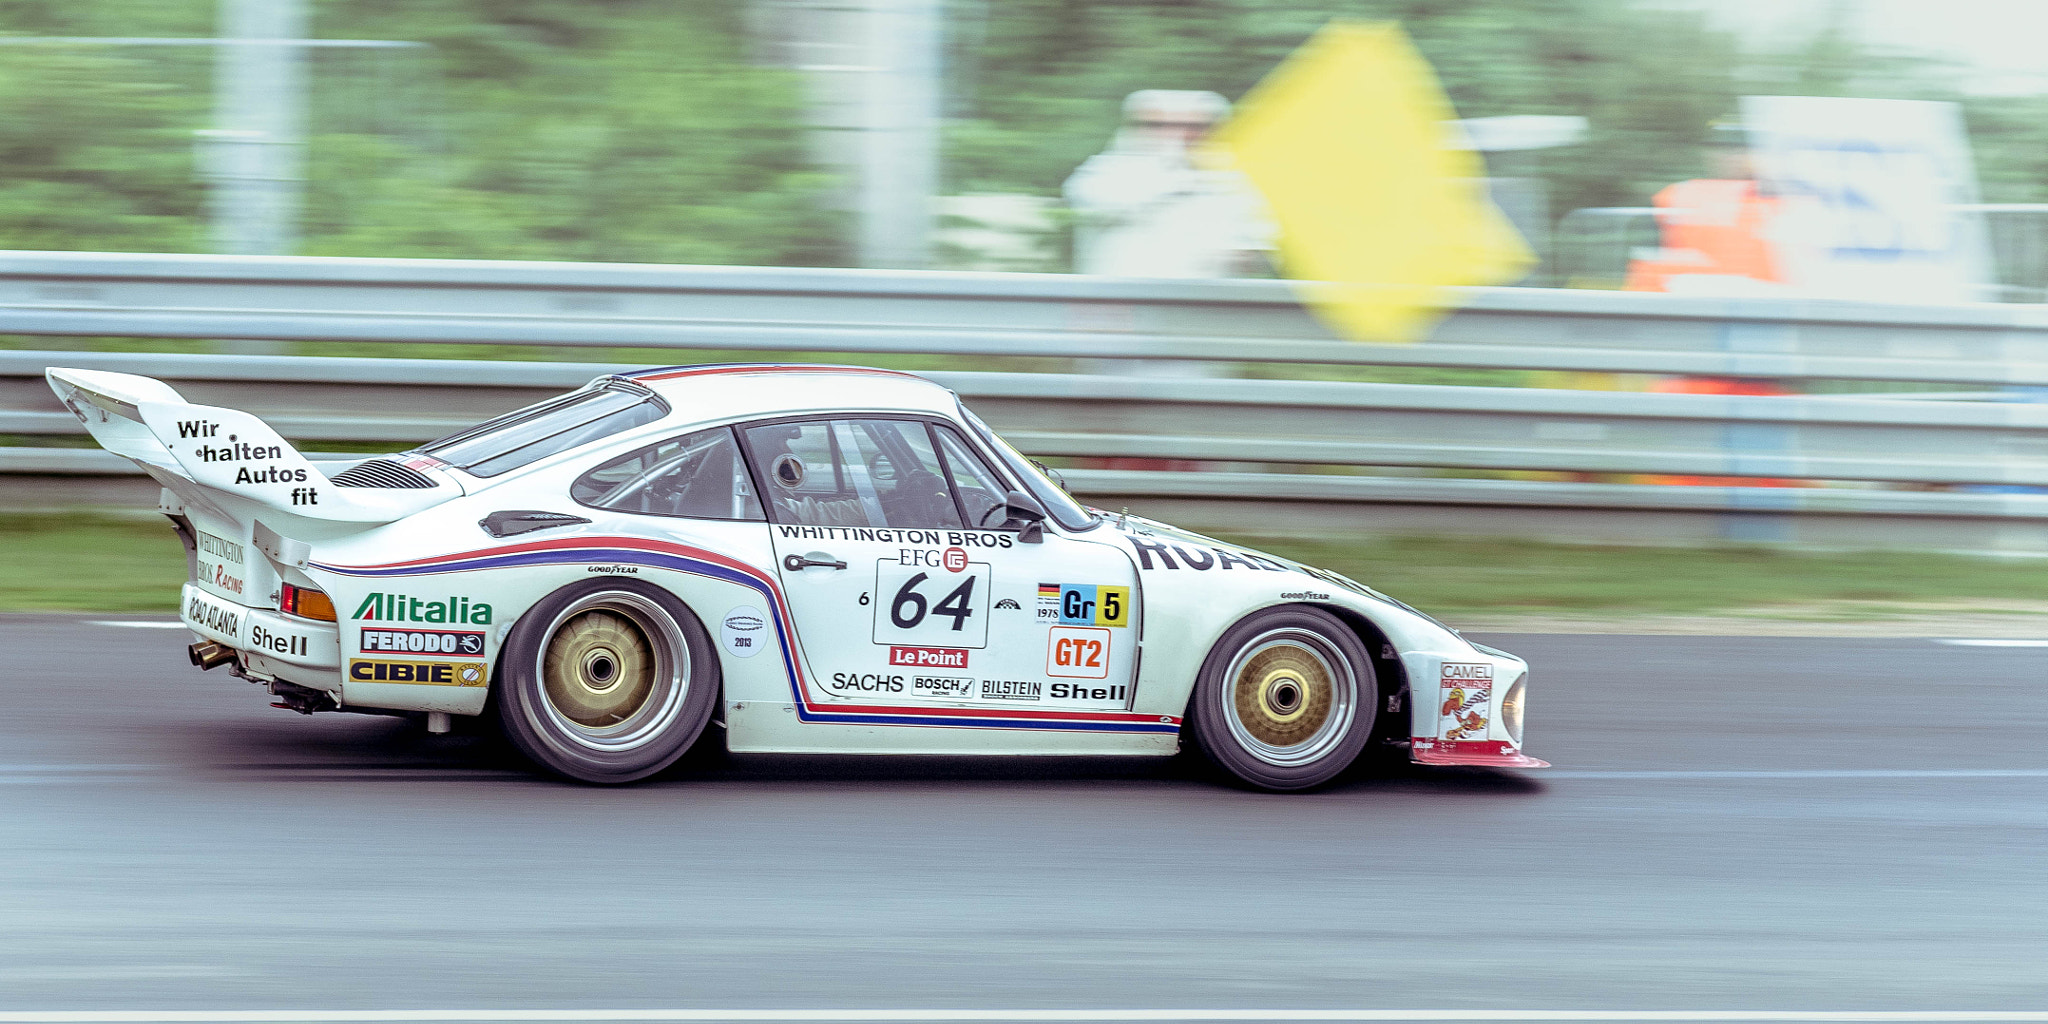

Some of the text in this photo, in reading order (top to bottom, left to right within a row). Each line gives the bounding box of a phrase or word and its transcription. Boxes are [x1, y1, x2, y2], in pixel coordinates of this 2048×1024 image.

[177, 420, 220, 438] Wir
[203, 443, 282, 462] halten
[235, 466, 307, 485] Autos
[291, 488, 318, 506] fit
[779, 525, 1013, 548] WHITTINGTON BROS
[198, 530, 244, 564] WHITTINGTON
[899, 548, 941, 567] EFG
[588, 564, 638, 574] GOODYEAR
[215, 564, 243, 594] RACING
[858, 592, 870, 606] 6
[891, 571, 977, 632] 64
[1280, 591, 1330, 600] GOODYEAR
[351, 593, 493, 625] Alitalia
[1037, 608, 1059, 618] 1978
[1063, 590, 1120, 621] Gr 5
[189, 597, 238, 638] ROAD ATLANTA
[252, 625, 308, 656] Shell
[363, 631, 457, 653] FERODO
[734, 637, 752, 647] 2013
[895, 650, 964, 666] Le Point
[1055, 638, 1102, 667] GT2
[1442, 665, 1492, 678] CAMEL
[832, 672, 904, 692] SACHS
[915, 678, 960, 690] BOSCH
[982, 680, 1042, 696] BILSTEIN
[1050, 683, 1126, 700] Shell
